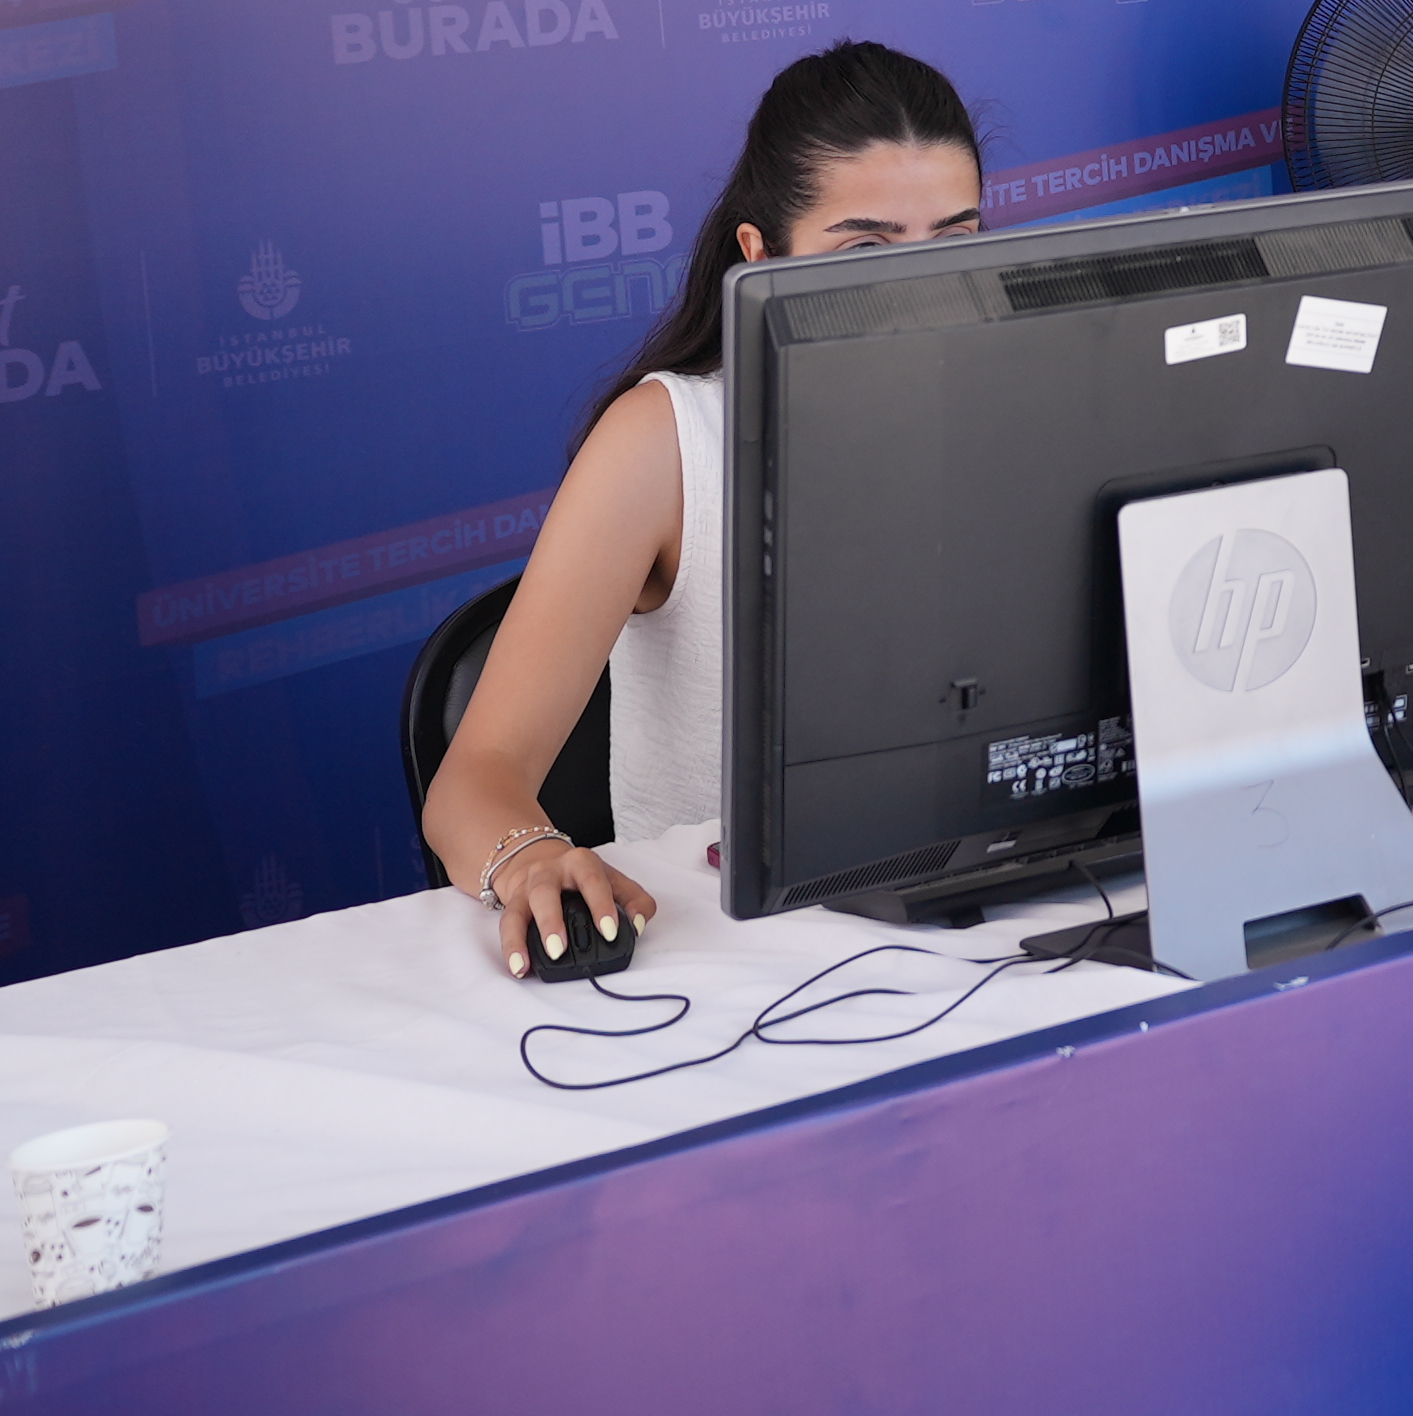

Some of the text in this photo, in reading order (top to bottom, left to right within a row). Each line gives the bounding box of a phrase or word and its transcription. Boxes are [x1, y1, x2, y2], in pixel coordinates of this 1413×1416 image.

[698, 0, 831, 30] BÜYÜKŞEHİR
[1031, 152, 1128, 199] TERCİH
[1132, 127, 1256, 176] DANIŞMA
